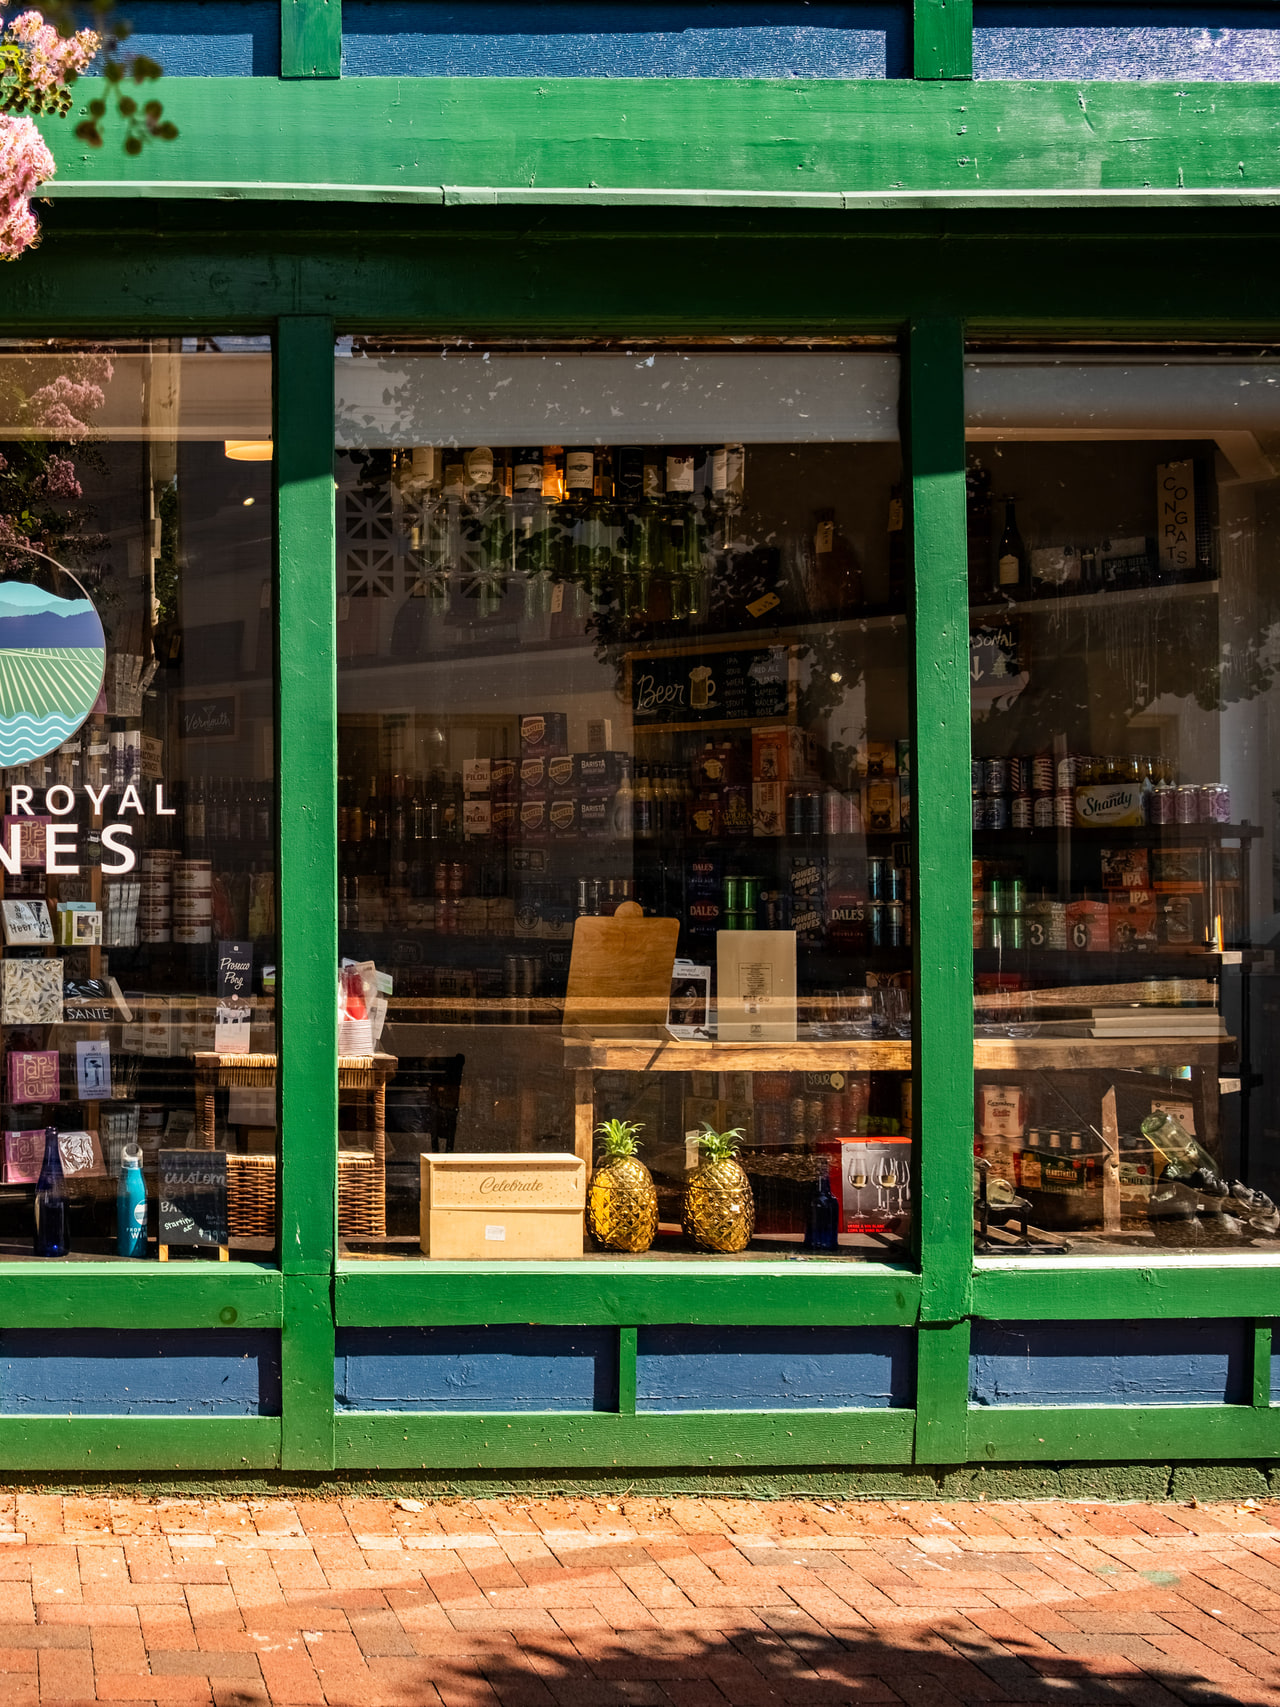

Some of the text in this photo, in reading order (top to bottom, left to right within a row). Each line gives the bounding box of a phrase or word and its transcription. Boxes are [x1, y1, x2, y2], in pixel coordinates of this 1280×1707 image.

[636, 674, 685, 710] Beer
[581, 760, 606, 769] BARISTA
[11, 784, 177, 816] ROYAL
[1082, 792, 1132, 816] Shandy
[581, 804, 606, 813] BARISTA
[791, 866, 817, 881] POWER
[794, 873, 820, 889] MOVES
[1122, 872, 1143, 887] IPA
[1129, 889, 1149, 904] IPA
[791, 911, 817, 926] POWER
[796, 918, 820, 932] MOVES
[1030, 923, 1044, 946] 3
[1073, 923, 1087, 948] 6
[220, 957, 251, 971] Prosecco
[224, 971, 244, 990] Pong
[807, 1073, 831, 1086] SOUR
[165, 1171, 227, 1186] custom
[480, 1176, 543, 1194] Celebrate
[165, 1217, 195, 1231] Starting
